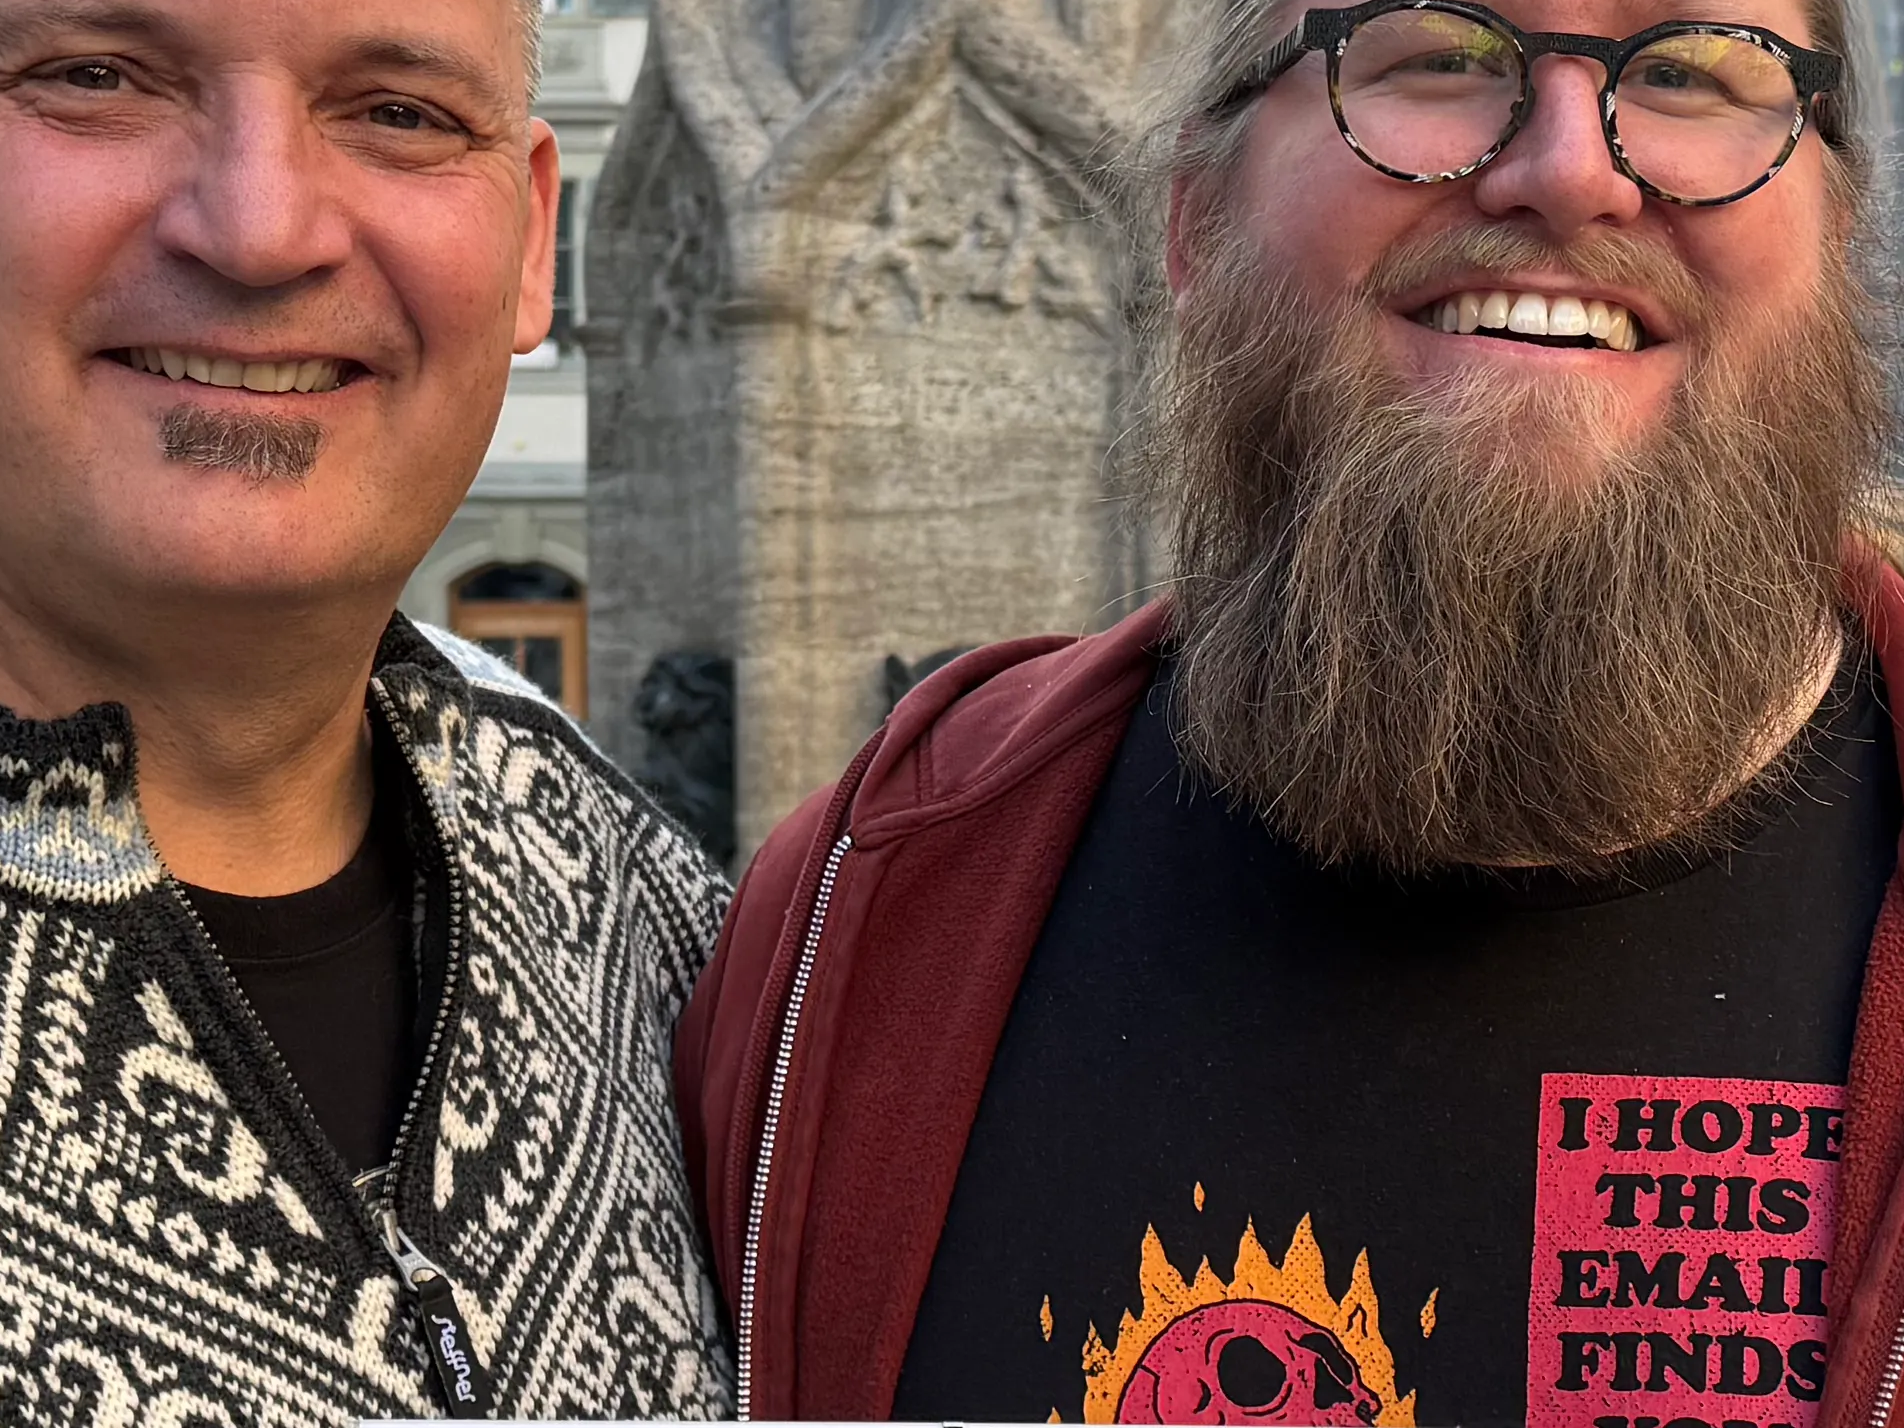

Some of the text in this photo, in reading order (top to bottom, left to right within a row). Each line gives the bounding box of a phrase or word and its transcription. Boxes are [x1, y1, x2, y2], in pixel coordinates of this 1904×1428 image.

[1557, 1097, 1846, 1162] I HOPE
[1596, 1173, 1811, 1235] THIS
[1555, 1330, 1828, 1402] FINDS
